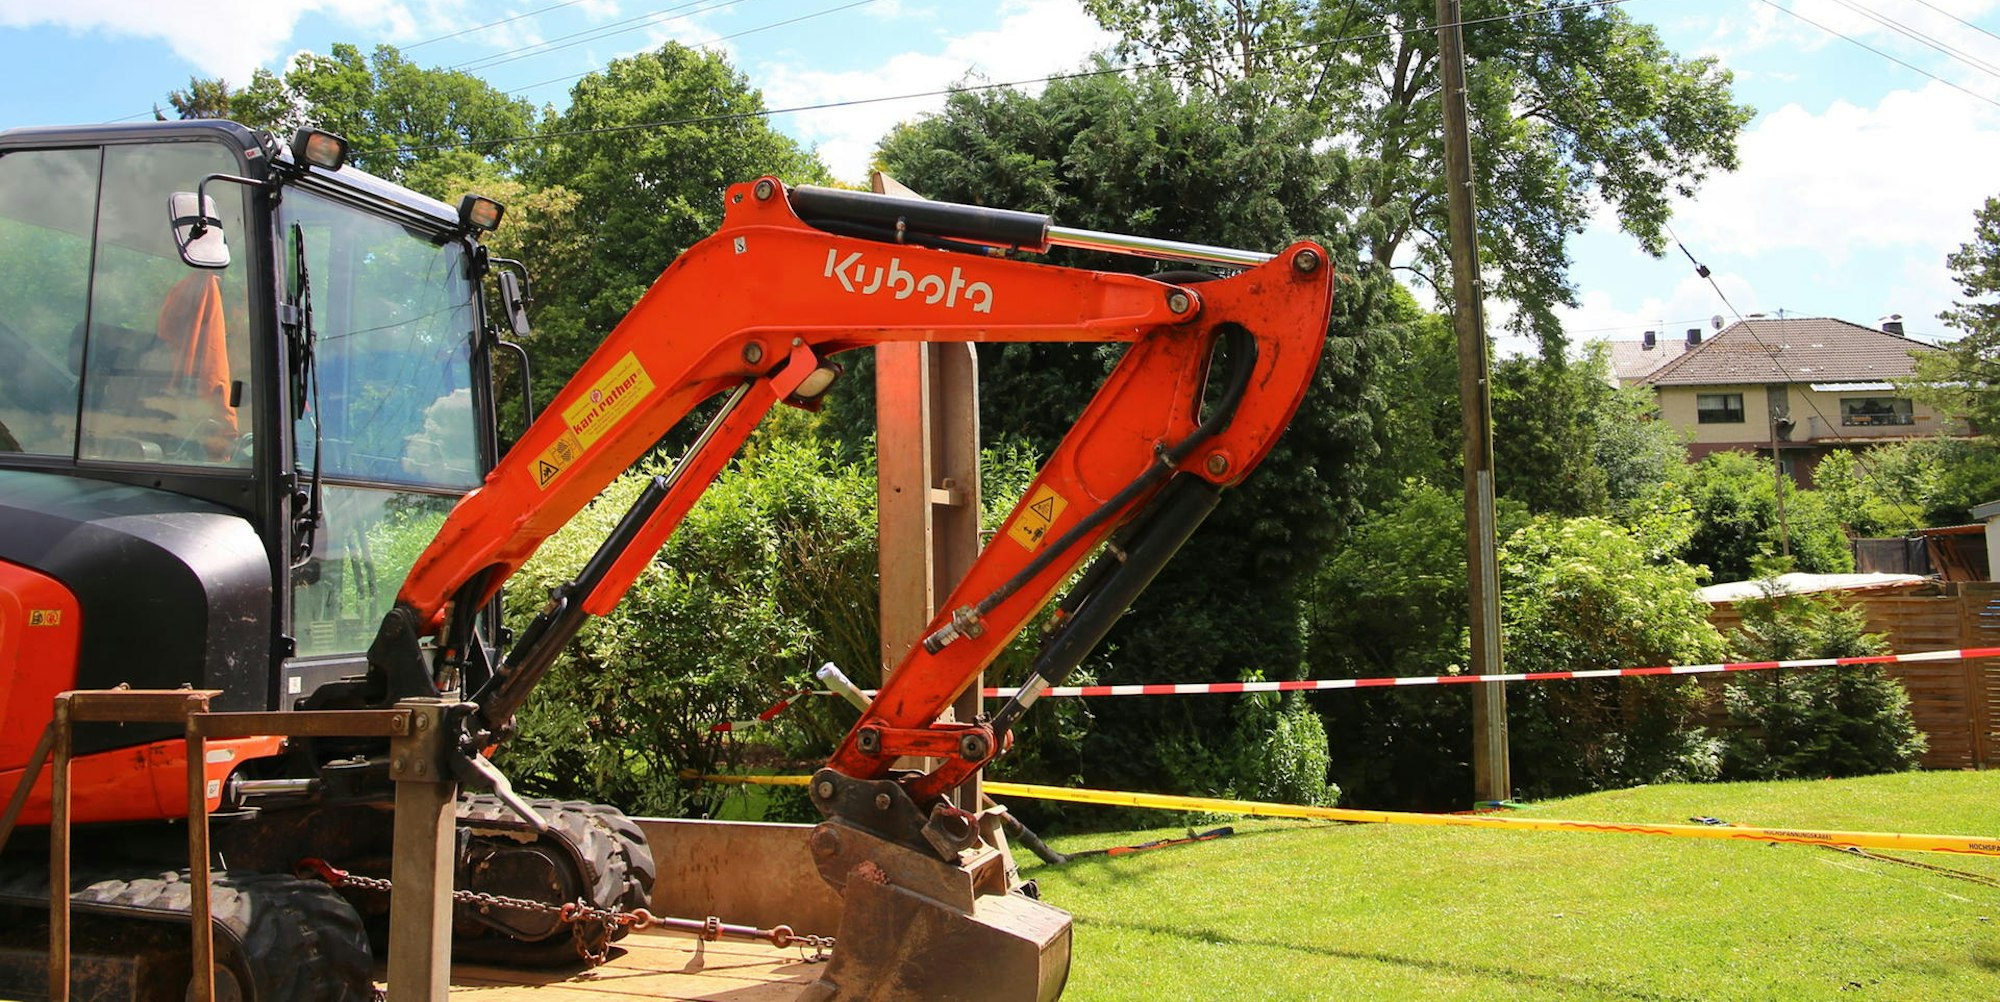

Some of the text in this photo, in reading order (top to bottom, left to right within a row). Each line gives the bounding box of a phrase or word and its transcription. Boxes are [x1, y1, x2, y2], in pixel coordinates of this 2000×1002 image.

[824, 249, 993, 313] Kubota
[573, 408, 599, 435] karl
[599, 373, 637, 412] rother
